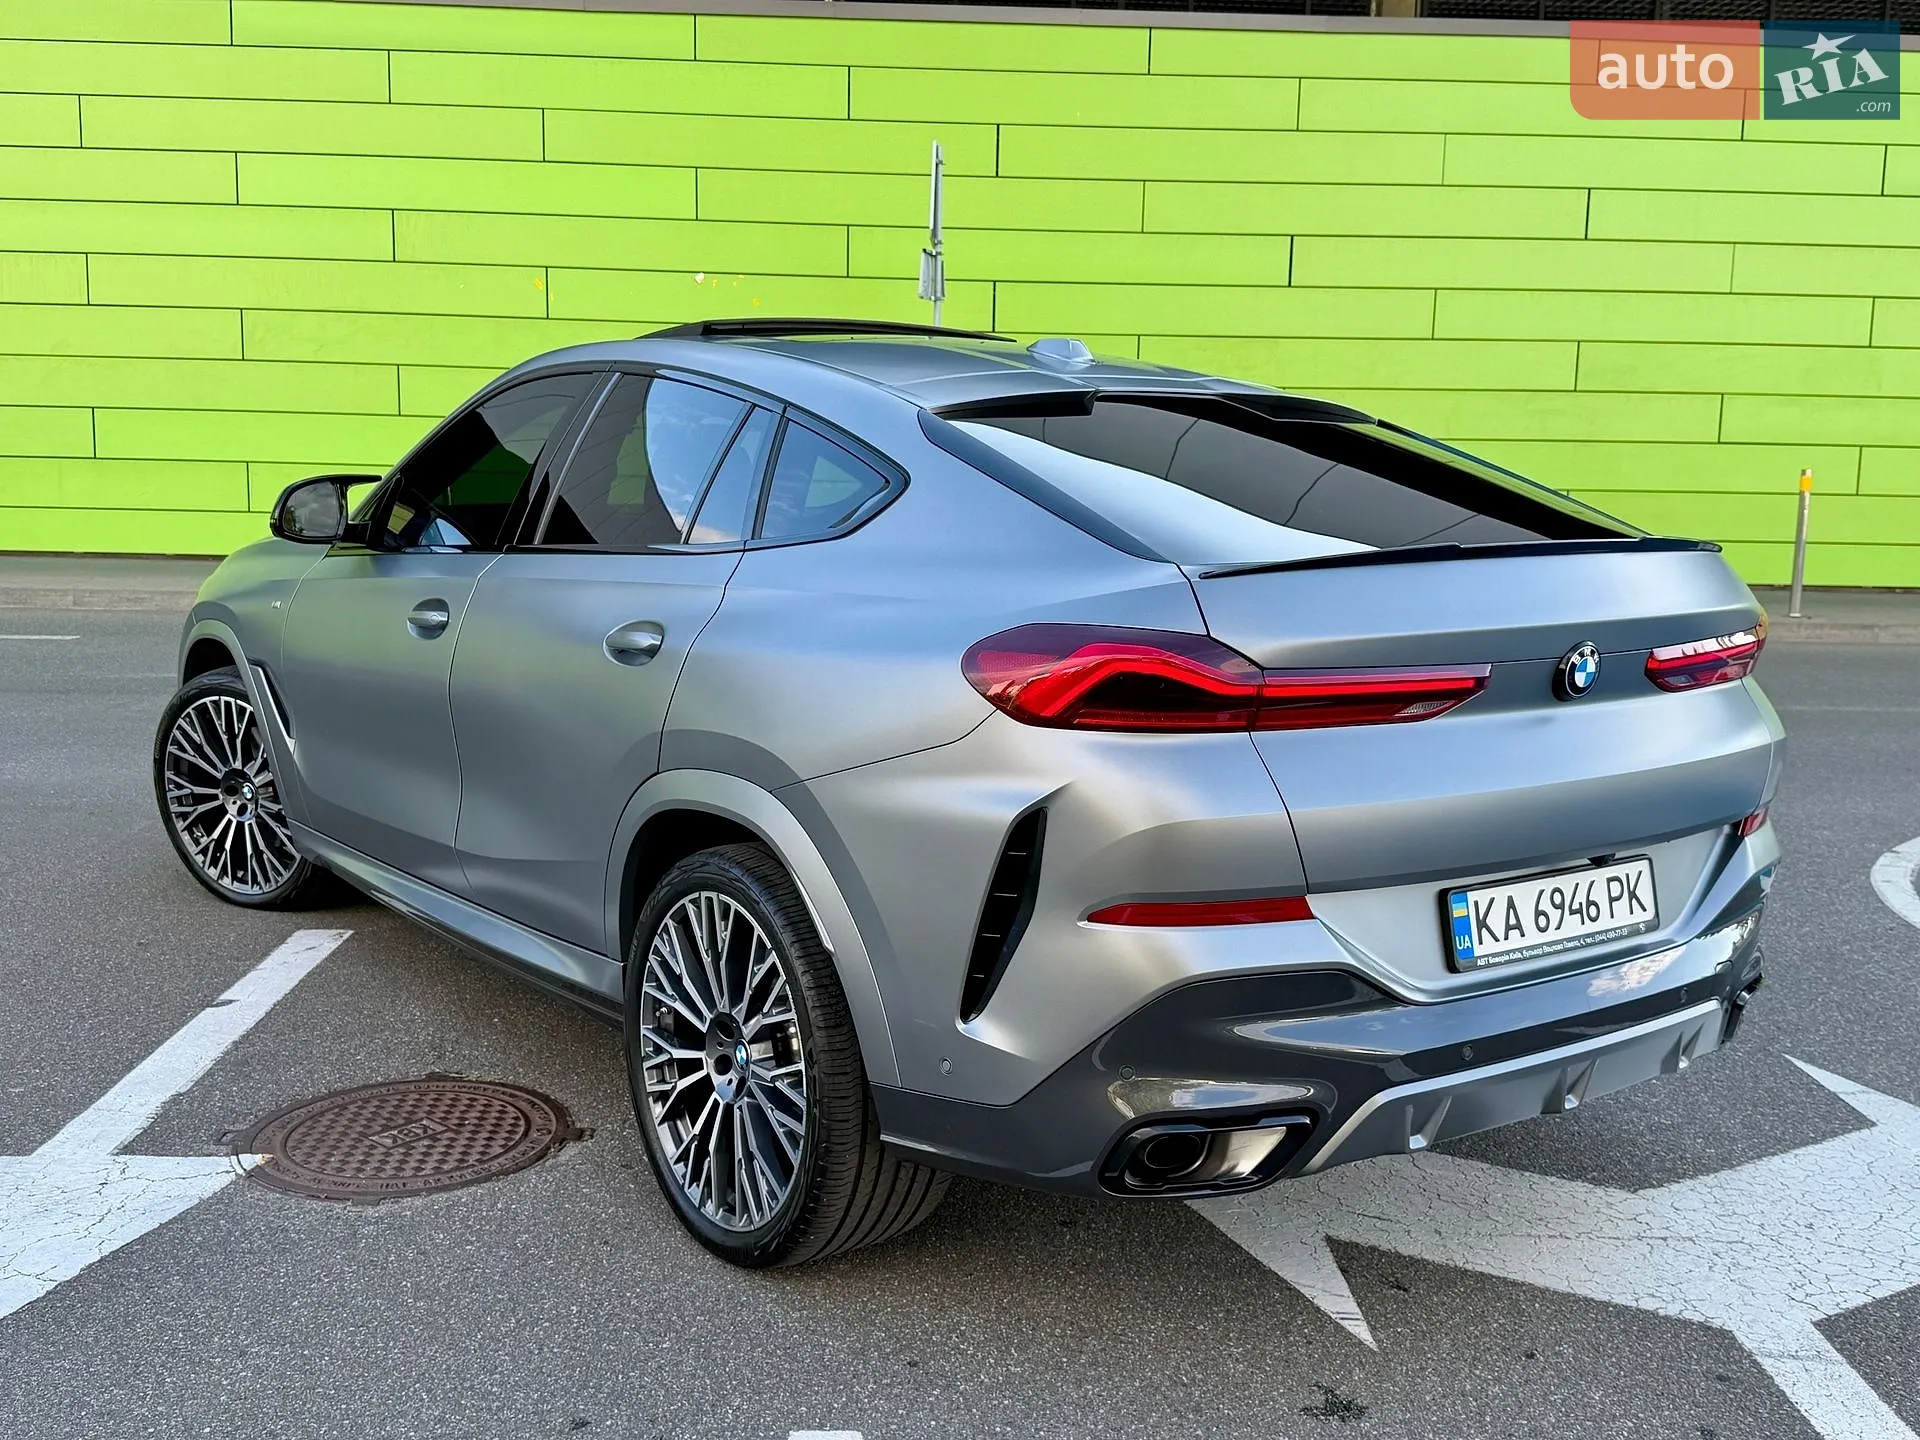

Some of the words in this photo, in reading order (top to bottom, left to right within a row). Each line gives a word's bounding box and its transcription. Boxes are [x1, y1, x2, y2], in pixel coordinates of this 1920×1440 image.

[1473, 894, 1526, 945] KA
[1533, 879, 1602, 933] 6946
[1605, 870, 1648, 919] PK
[1456, 934, 1473, 950] UA
